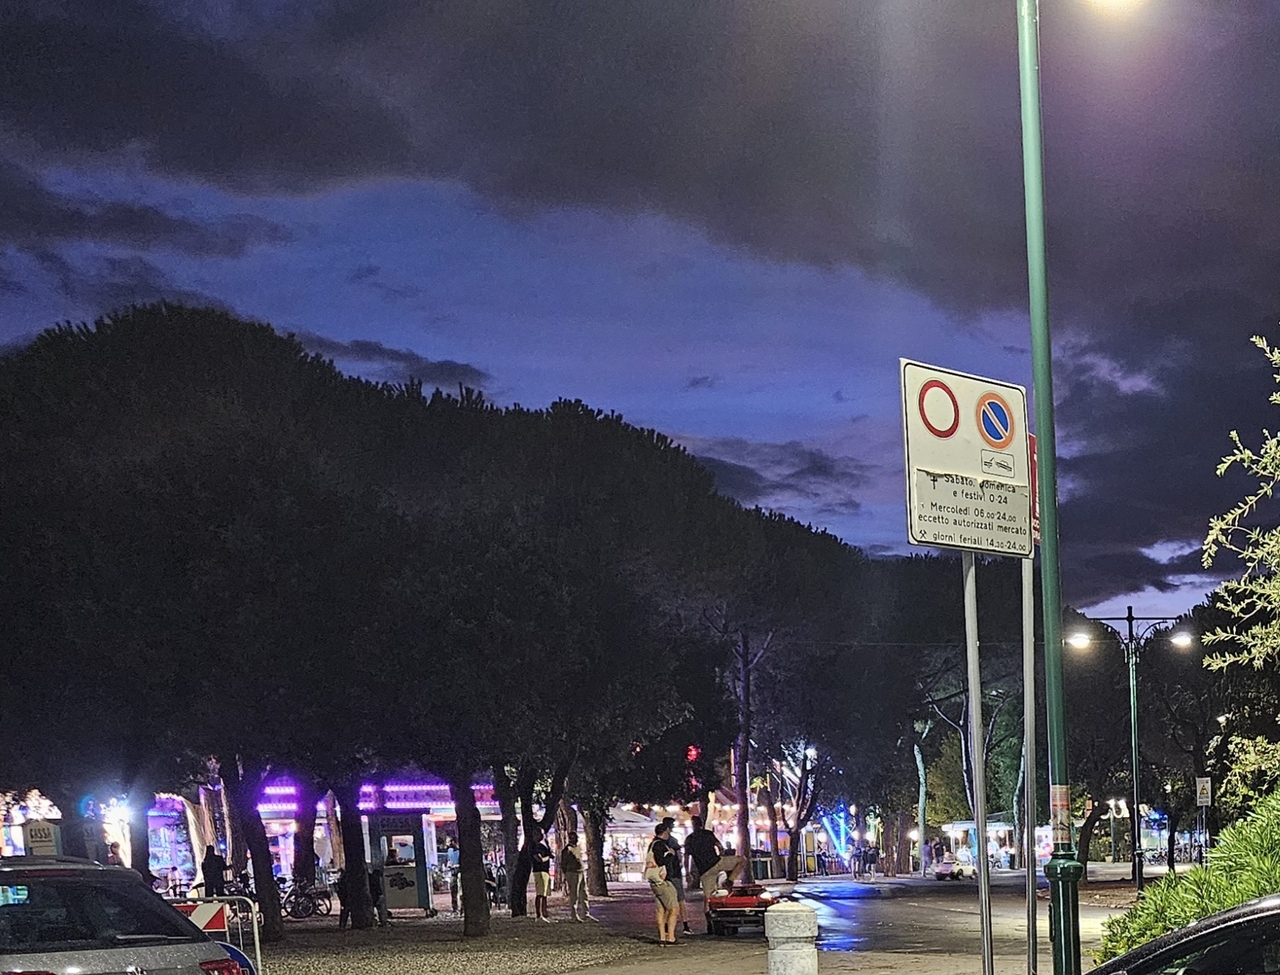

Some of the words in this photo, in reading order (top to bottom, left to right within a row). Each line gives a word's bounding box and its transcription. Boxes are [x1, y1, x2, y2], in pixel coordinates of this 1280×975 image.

[952, 490, 958, 498] e
[961, 489, 986, 502] festivi
[989, 494, 1008, 505] 0-24
[918, 513, 950, 525] eccetto
[952, 516, 994, 531] autorizzati
[997, 524, 1027, 536] mercato
[932, 531, 956, 543] giorni
[959, 534, 983, 546] feriali
[29, 827, 53, 839] CASSA
